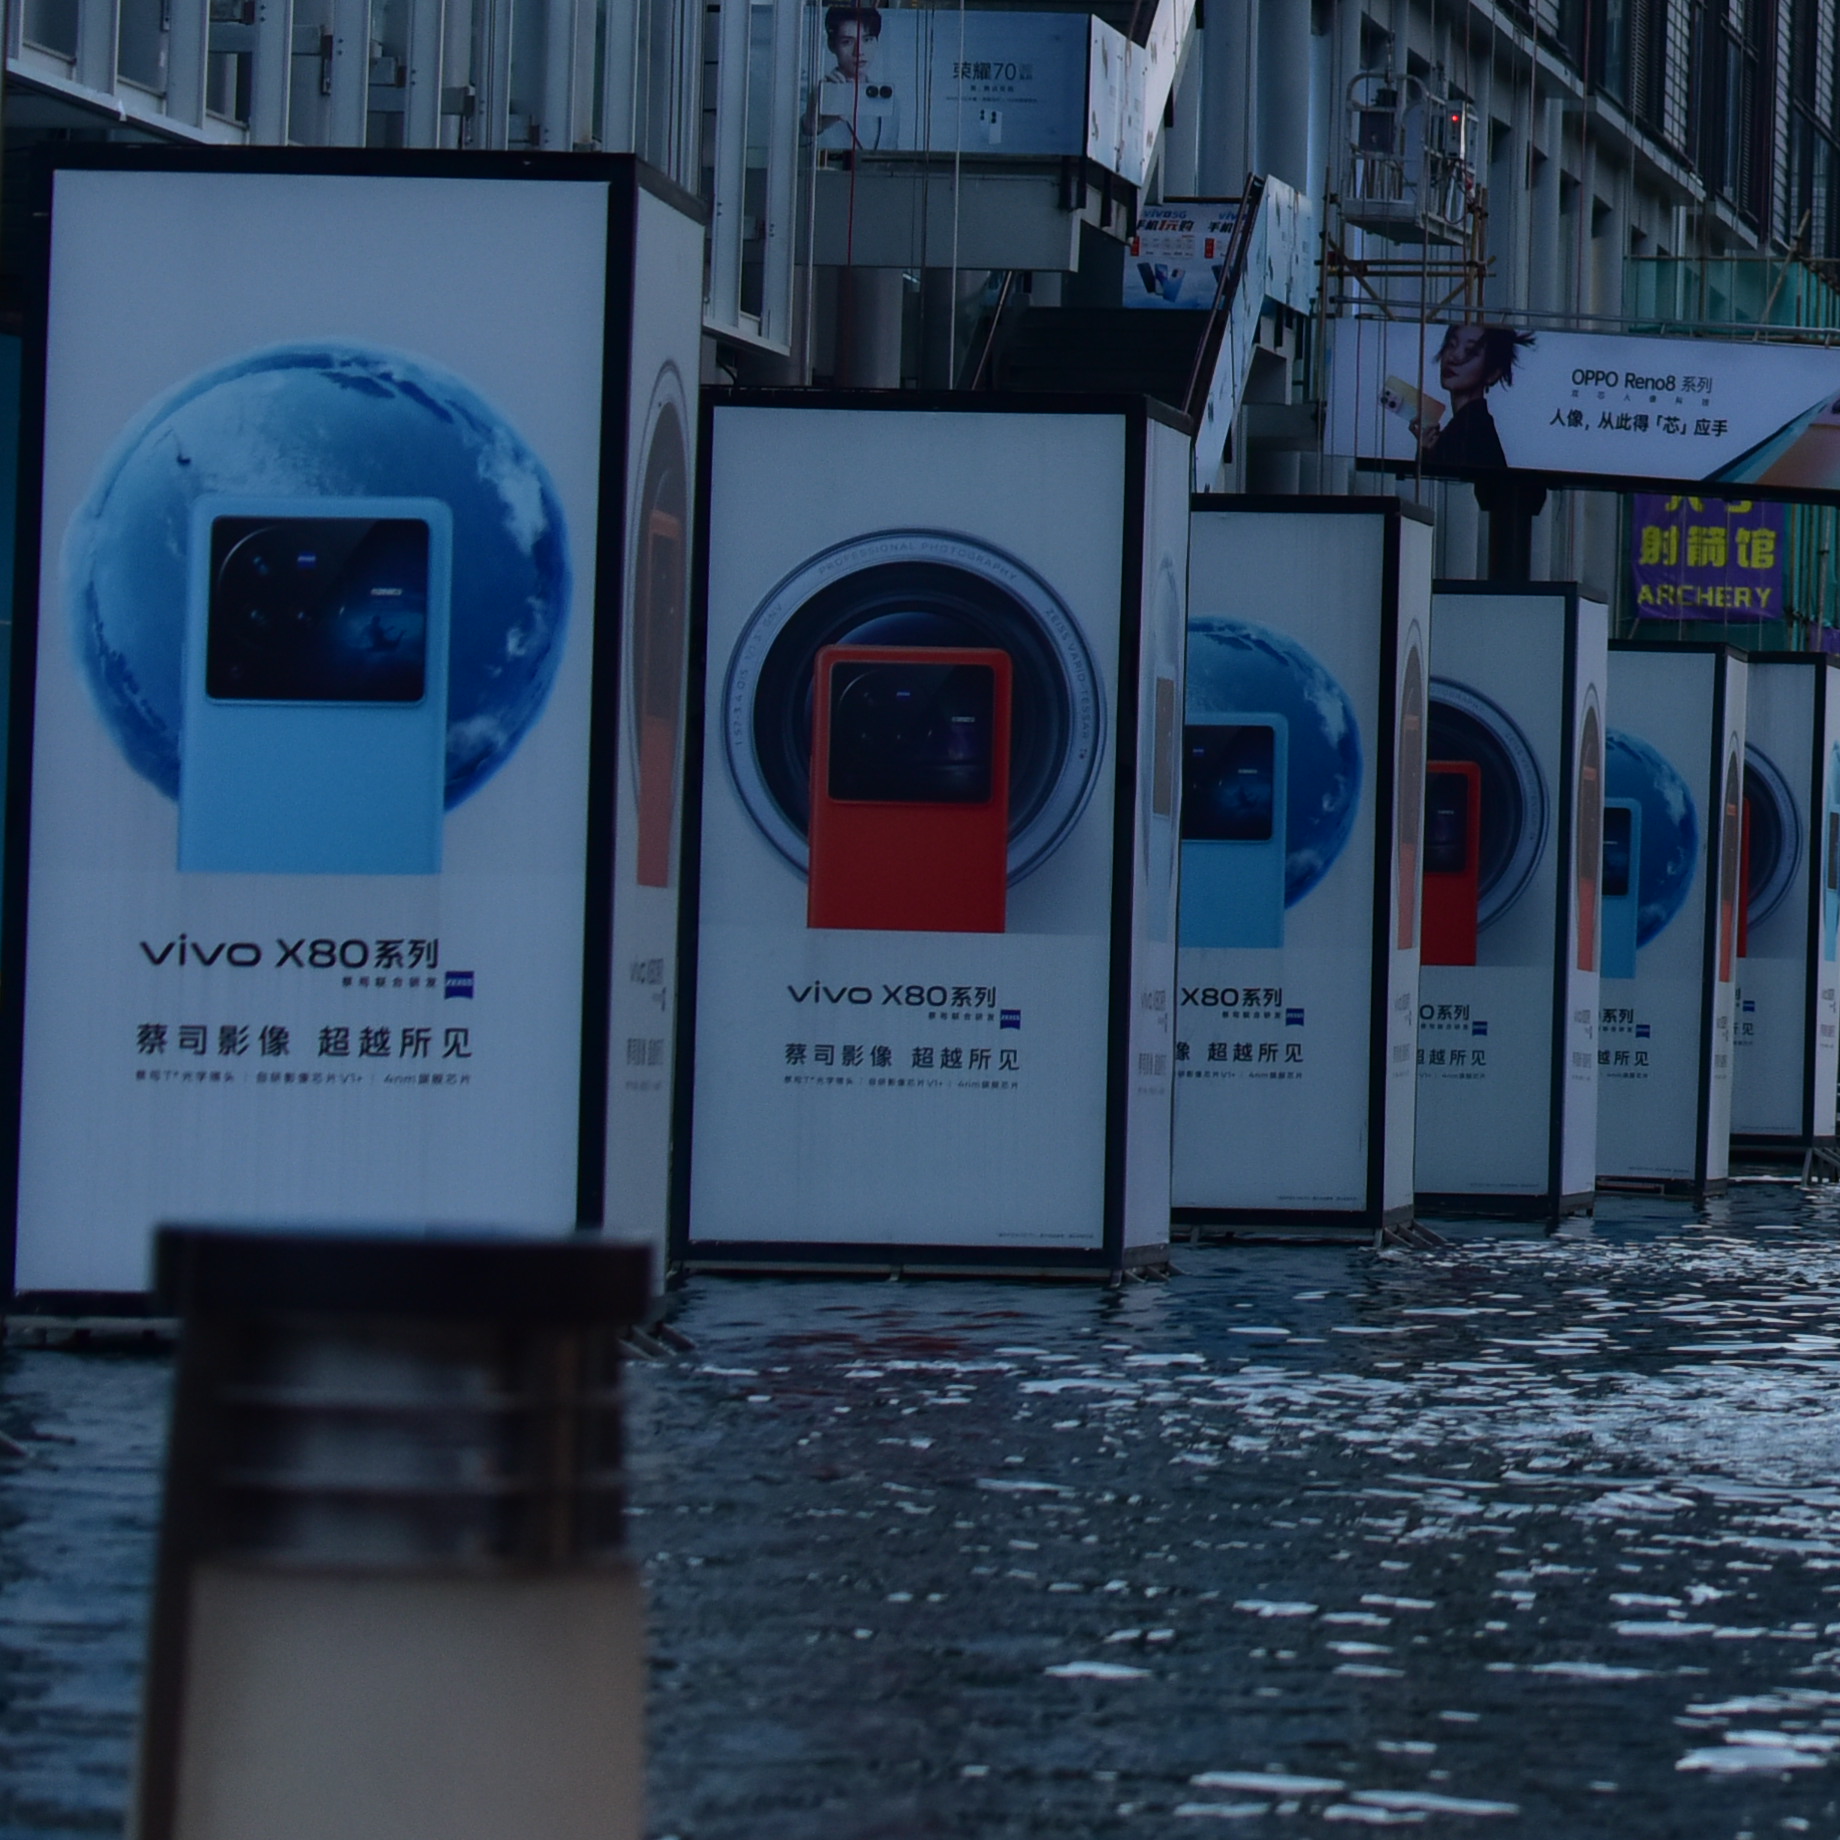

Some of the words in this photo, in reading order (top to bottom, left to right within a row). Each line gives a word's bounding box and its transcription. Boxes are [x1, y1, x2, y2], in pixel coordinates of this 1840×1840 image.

[1571, 369, 1619, 388] OPPO
[1624, 372, 1676, 391] Reno8
[1681, 376, 1712, 394] 系列
[1638, 525, 1777, 569] 射箭馆
[1637, 584, 1772, 608] ARCHERY
[139, 933, 262, 967] vivo
[275, 938, 440, 970] X80系列
[787, 980, 873, 1005] vivo
[881, 984, 996, 1008] X80系列
[1180, 987, 1283, 1008] X80系列
[136, 1023, 290, 1056] 蔡司影像
[318, 1026, 473, 1058] 超越所见
[1207, 1043, 1304, 1063] 超越所见
[784, 1042, 893, 1068] 蔡司影像
[911, 1046, 1021, 1071] 超越所见
